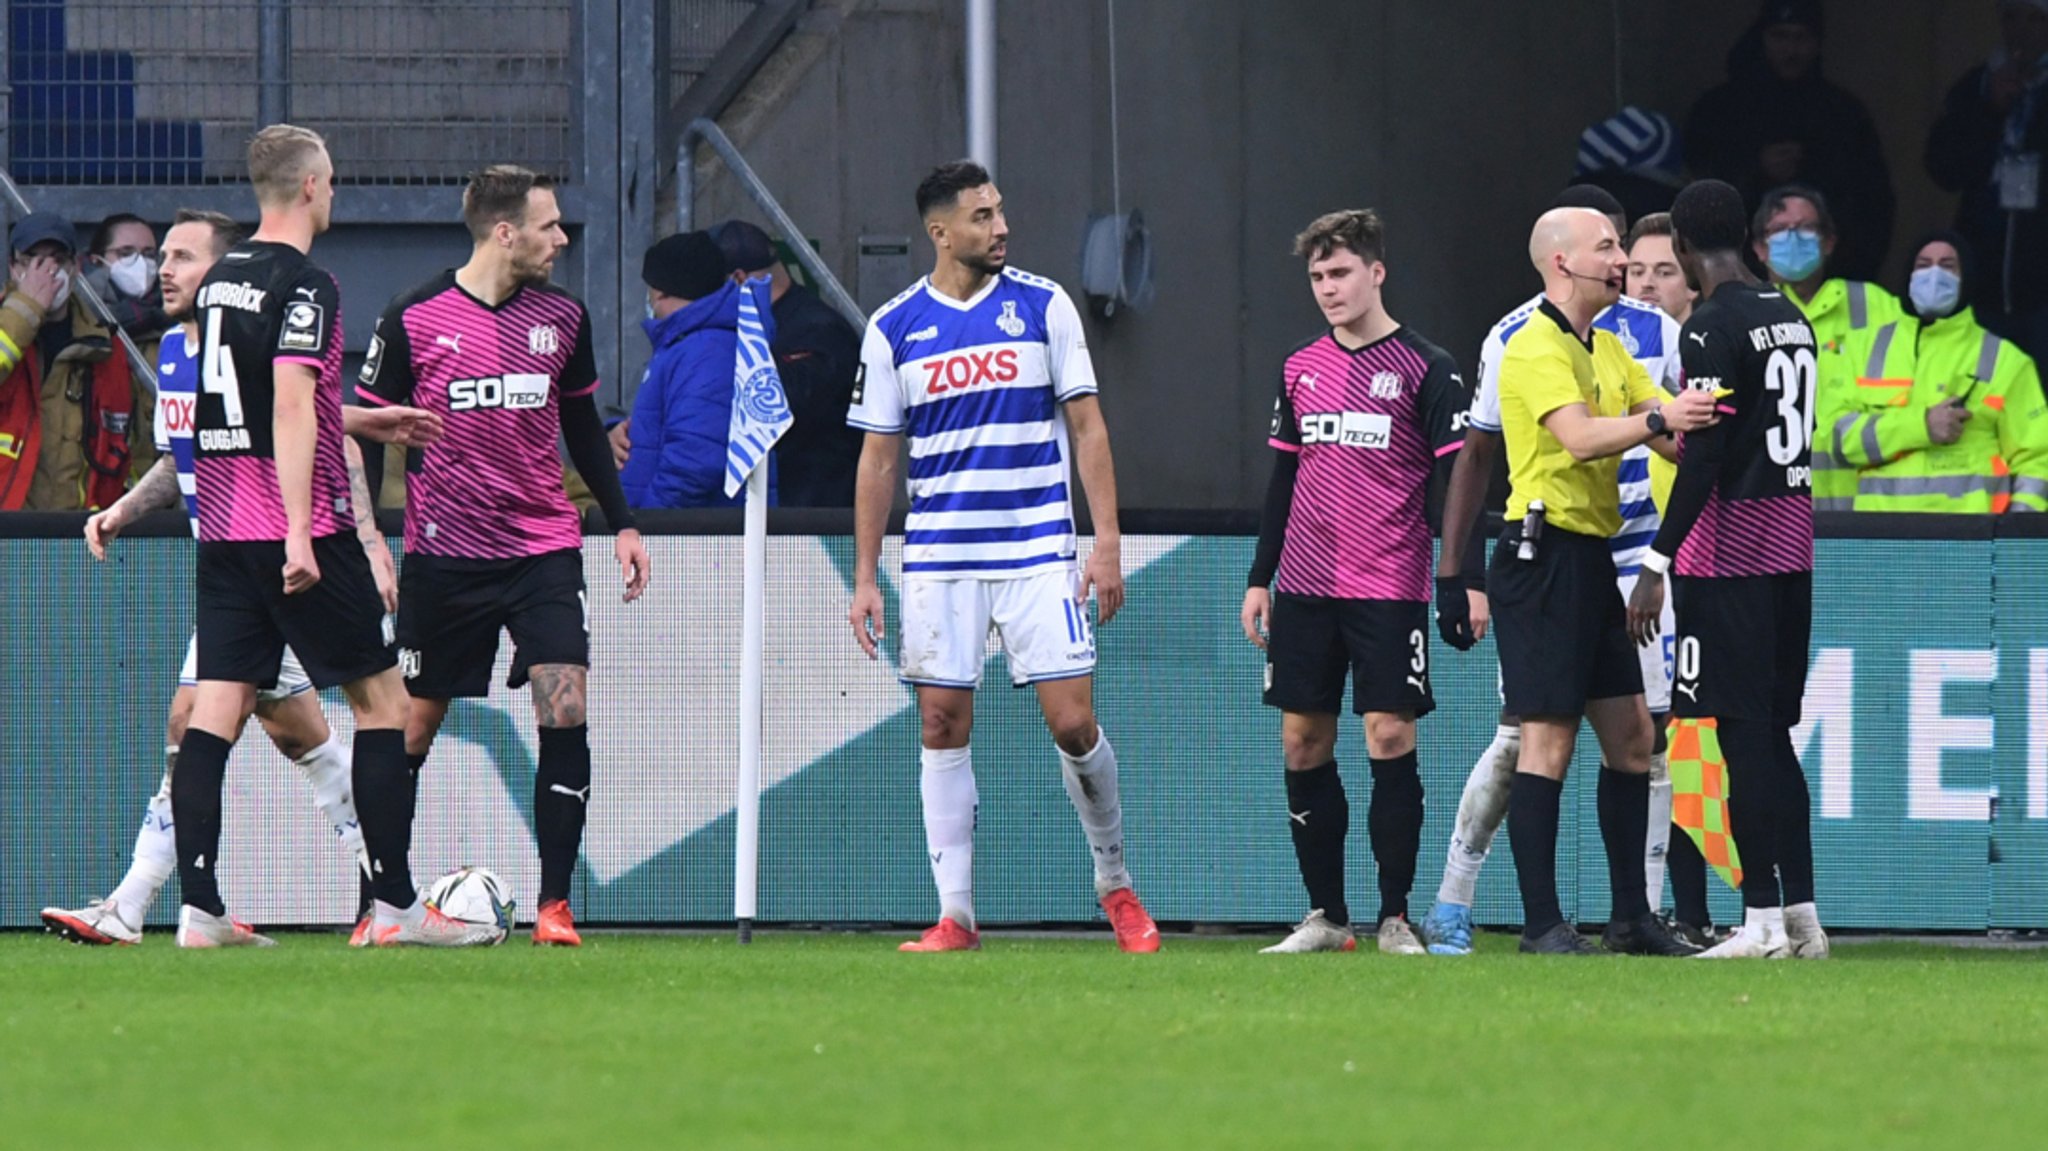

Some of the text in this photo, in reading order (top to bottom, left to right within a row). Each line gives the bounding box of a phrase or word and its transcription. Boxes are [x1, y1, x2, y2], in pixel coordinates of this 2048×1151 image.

[202, 307, 244, 427] 4
[923, 350, 1018, 394] ZOXS
[449, 377, 546, 411] SO TECH
[1765, 348, 1817, 465] 30
[1301, 413, 1386, 445] SO TECH
[1409, 628, 1426, 673] 3
[193, 853, 205, 870] 4
